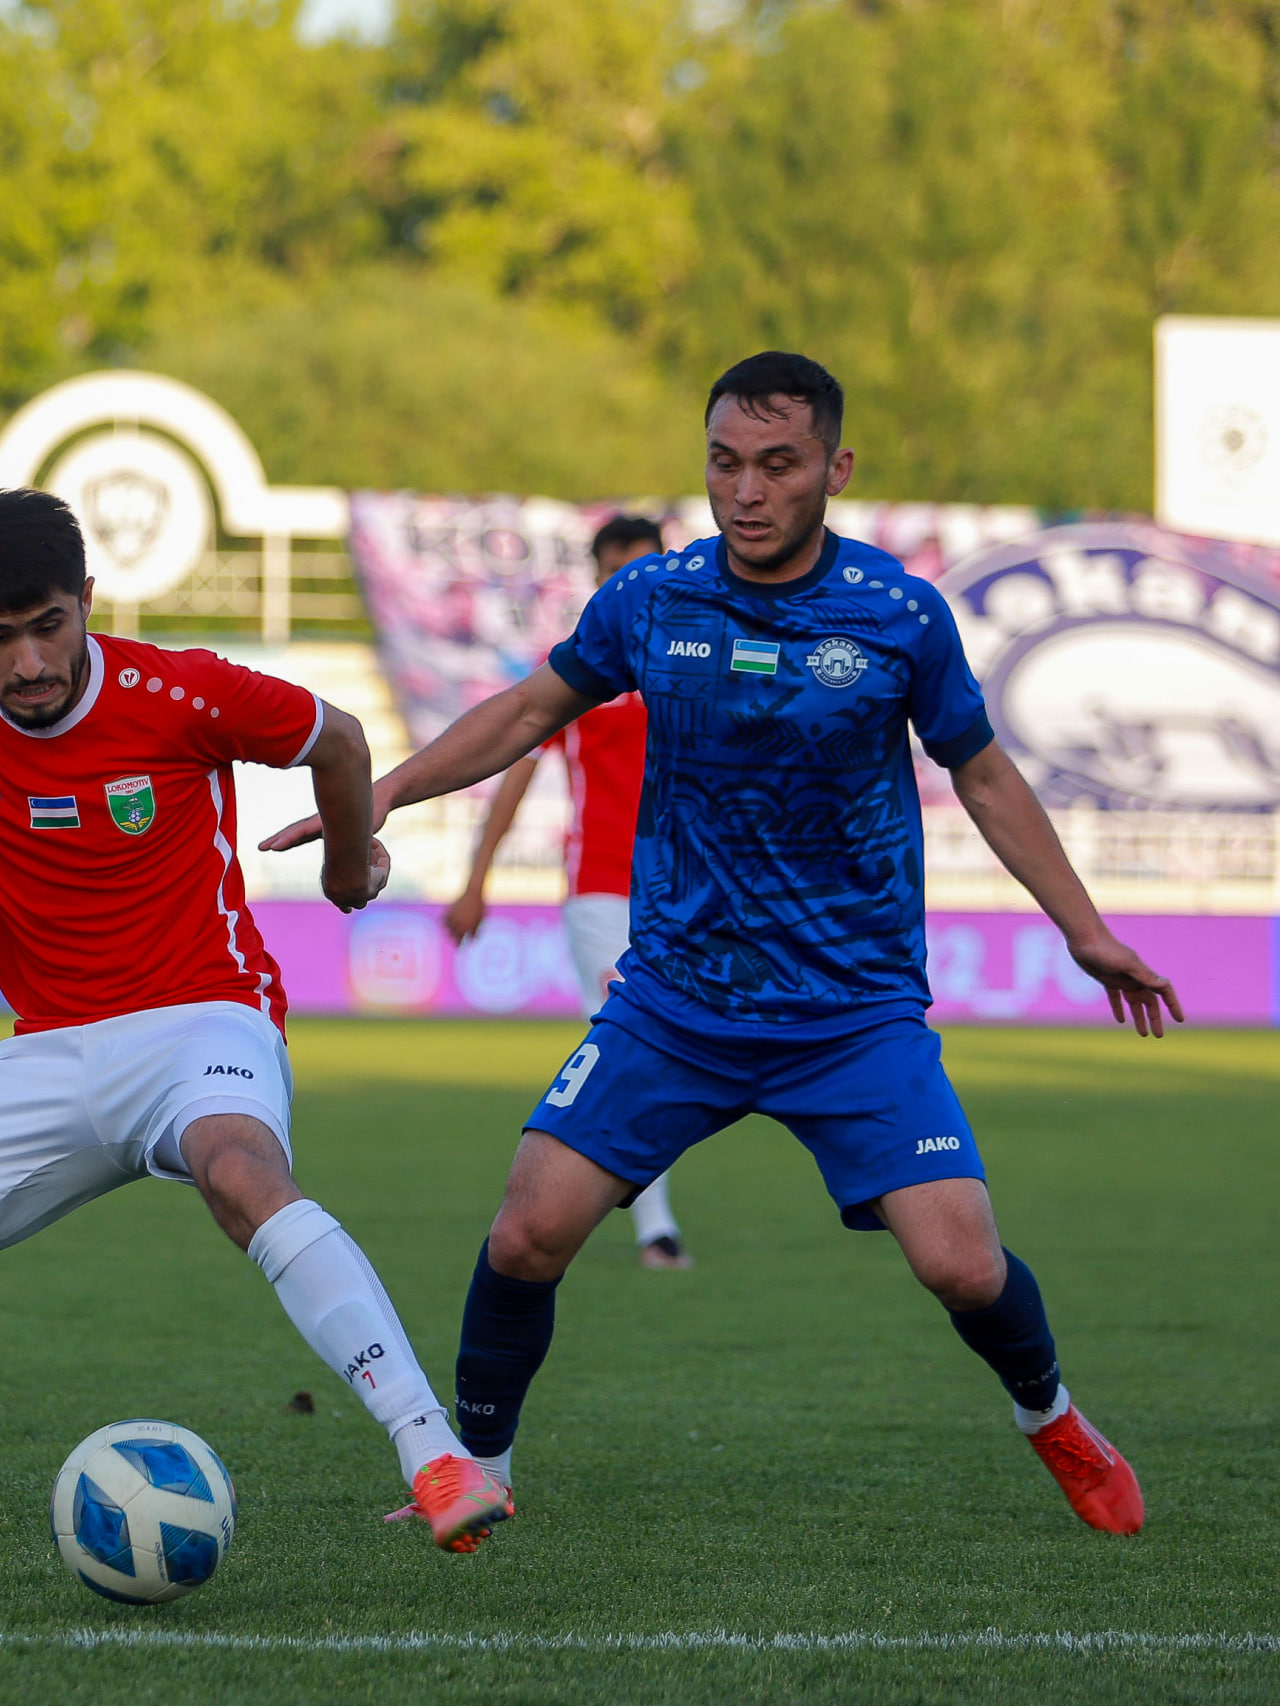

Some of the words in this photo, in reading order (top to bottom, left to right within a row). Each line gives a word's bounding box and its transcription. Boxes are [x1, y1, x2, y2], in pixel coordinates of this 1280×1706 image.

[667, 641, 711, 658] JAKO
[106, 778, 149, 793] LOKOMOTIV
[203, 1064, 255, 1080] JAKO
[545, 1043, 600, 1108] 9
[915, 1136, 960, 1155] JAKO
[343, 1342, 386, 1385] JAKO
[361, 1370, 376, 1390] 7
